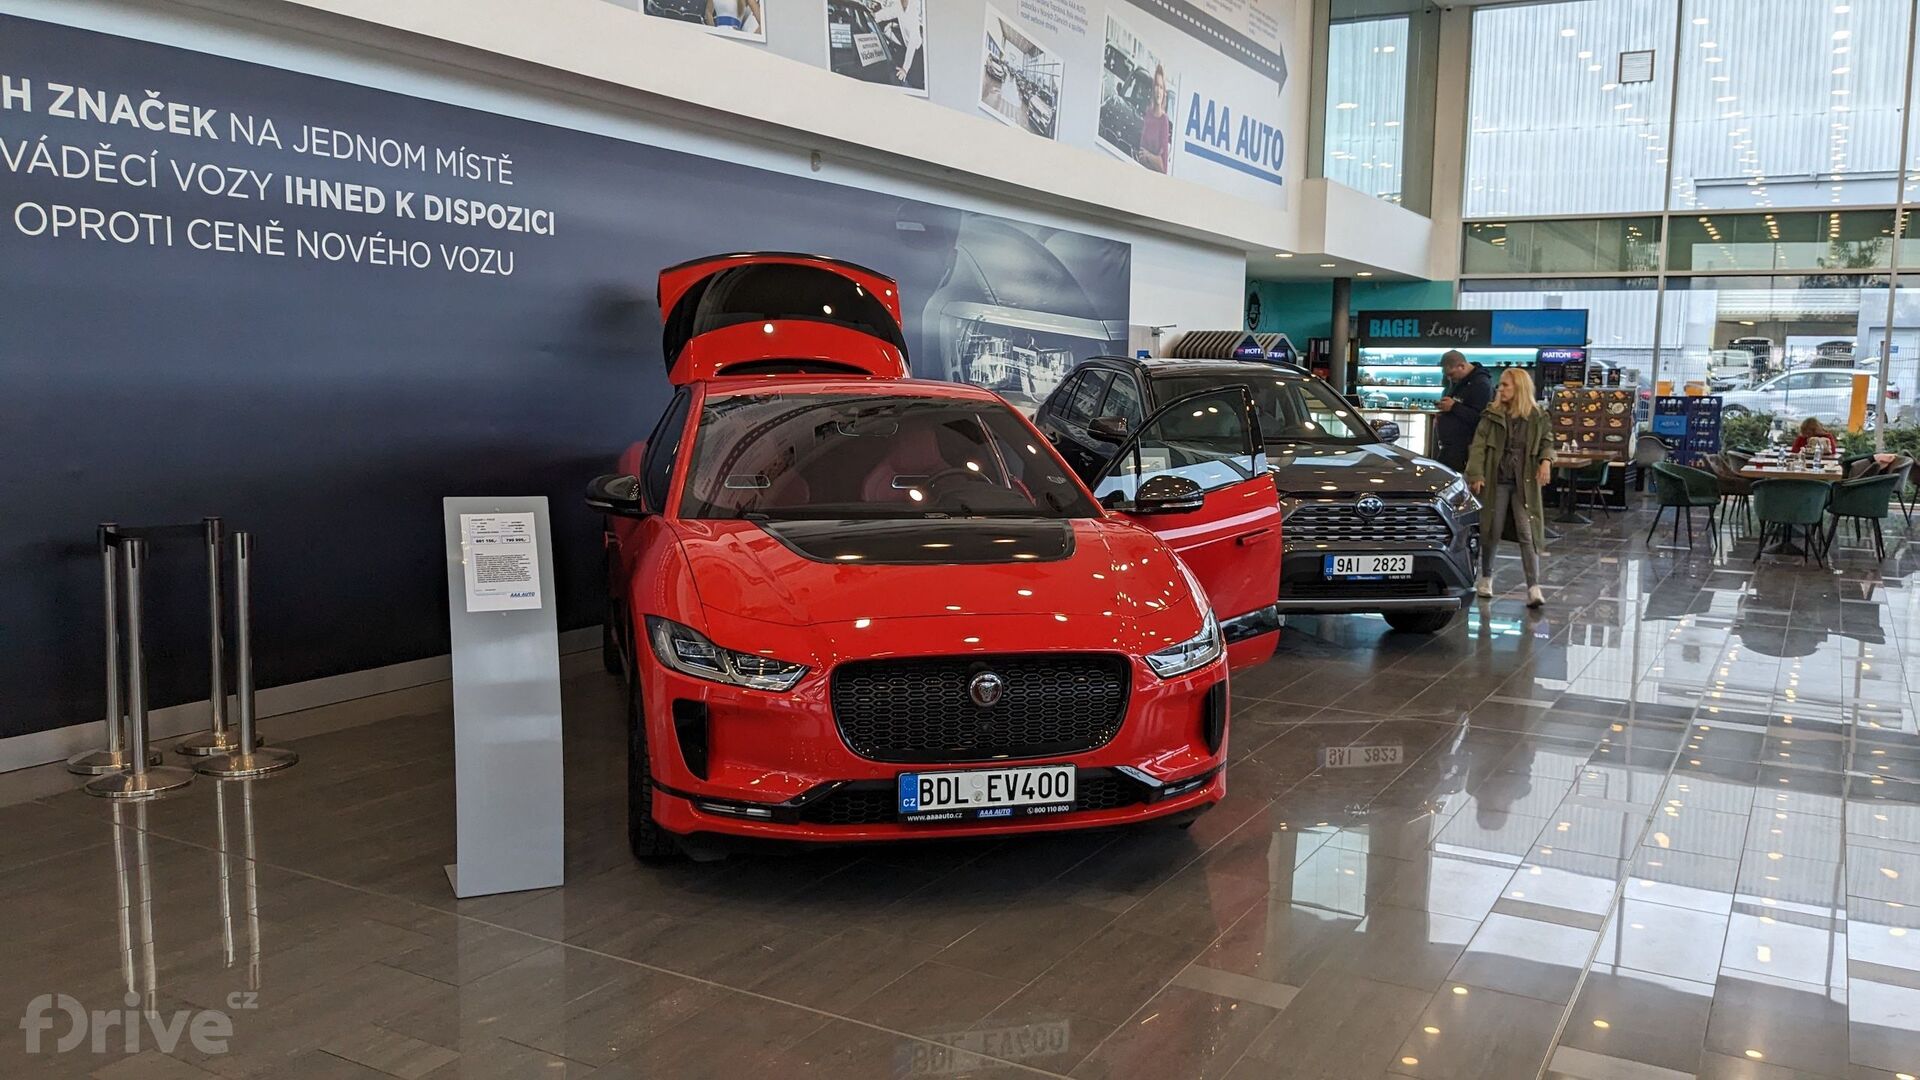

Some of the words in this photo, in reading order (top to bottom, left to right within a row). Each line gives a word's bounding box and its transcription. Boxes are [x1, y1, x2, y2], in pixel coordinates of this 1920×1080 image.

[2, 75, 31, 112] H
[48, 82, 219, 140] ZNAČEK
[230, 112, 282, 150] NA
[293, 125, 426, 172] JEDNOM
[436, 146, 514, 185] MÍSTĚ
[1185, 92, 1230, 152] AAA
[1235, 115, 1284, 171] AUTO
[0, 134, 158, 188] VÁDĚCÍ
[170, 159, 273, 200] VOZY
[285, 175, 386, 214] IHNED
[396, 190, 416, 219] K
[424, 194, 555, 236] DISPOZICI
[14, 201, 172, 247] OPROTI
[187, 219, 285, 256] CENĚ
[297, 229, 432, 269] NOVÉHO
[440, 243, 514, 276] VOZU
[1369, 318, 1421, 338] BAGEL
[1426, 321, 1478, 342] Lounge
[1542, 351, 1571, 359] MATTONI
[1373, 557, 1406, 572] 2823
[919, 777, 969, 807] BDL
[987, 771, 1069, 802] EV400
[903, 798, 916, 808] CZ
[979, 809, 993, 817] AAA
[994, 808, 1012, 816] AUTO
[1034, 806, 1046, 814] 800
[1047, 805, 1057, 813] 110
[1058, 804, 1070, 812] 800
[907, 812, 963, 822] www.aaaauto.cz
